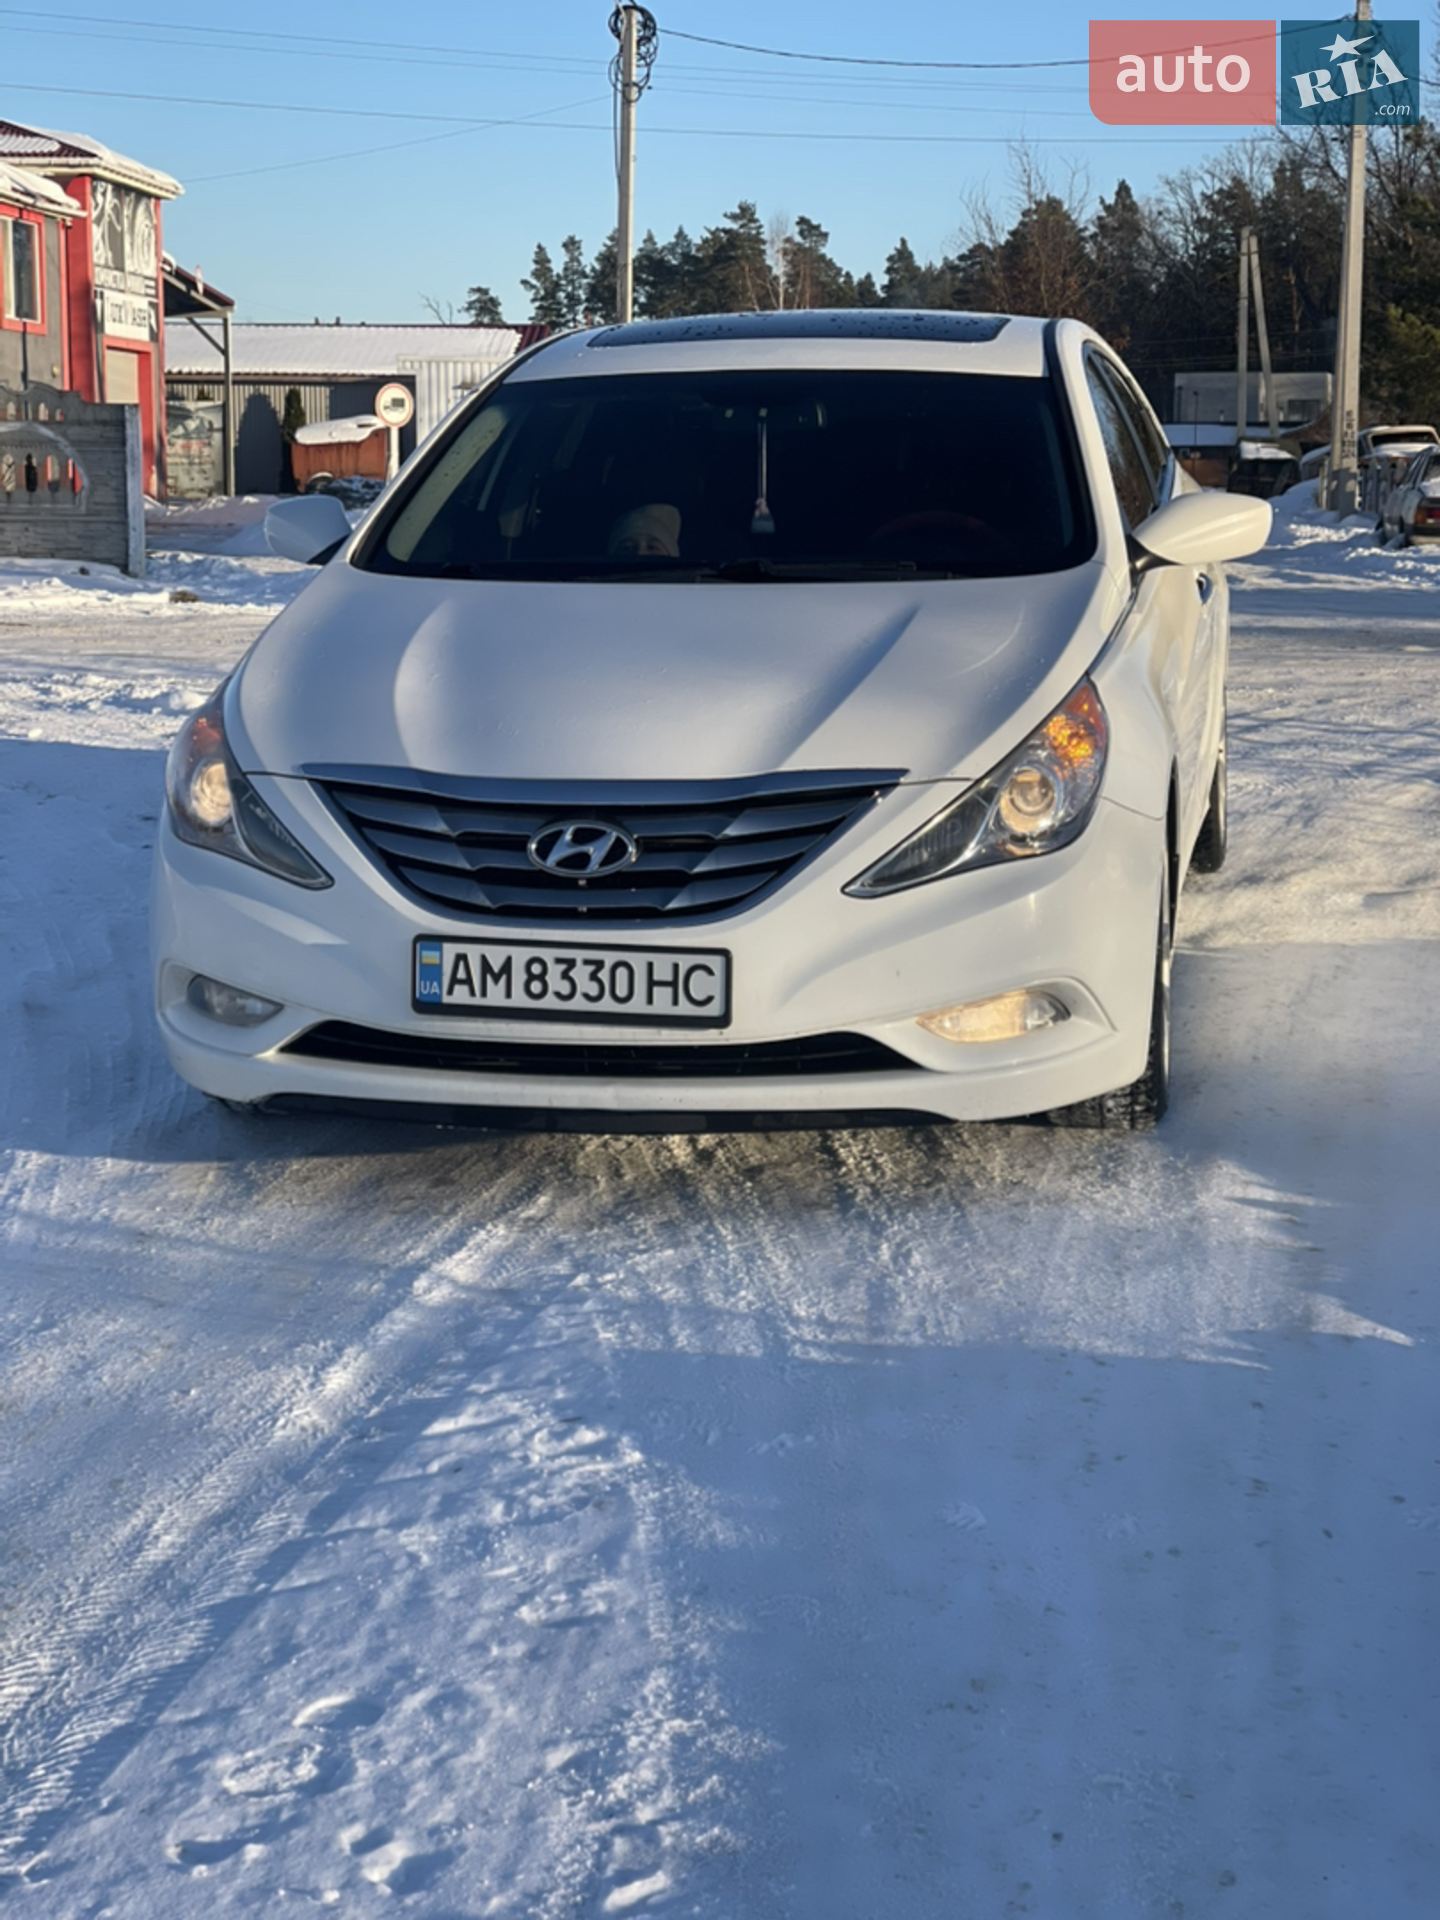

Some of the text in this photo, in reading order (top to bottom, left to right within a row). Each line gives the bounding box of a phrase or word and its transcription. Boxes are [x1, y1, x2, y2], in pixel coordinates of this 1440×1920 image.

[420, 981, 441, 995] UA
[446, 953, 716, 1008] AM 8330 HC
